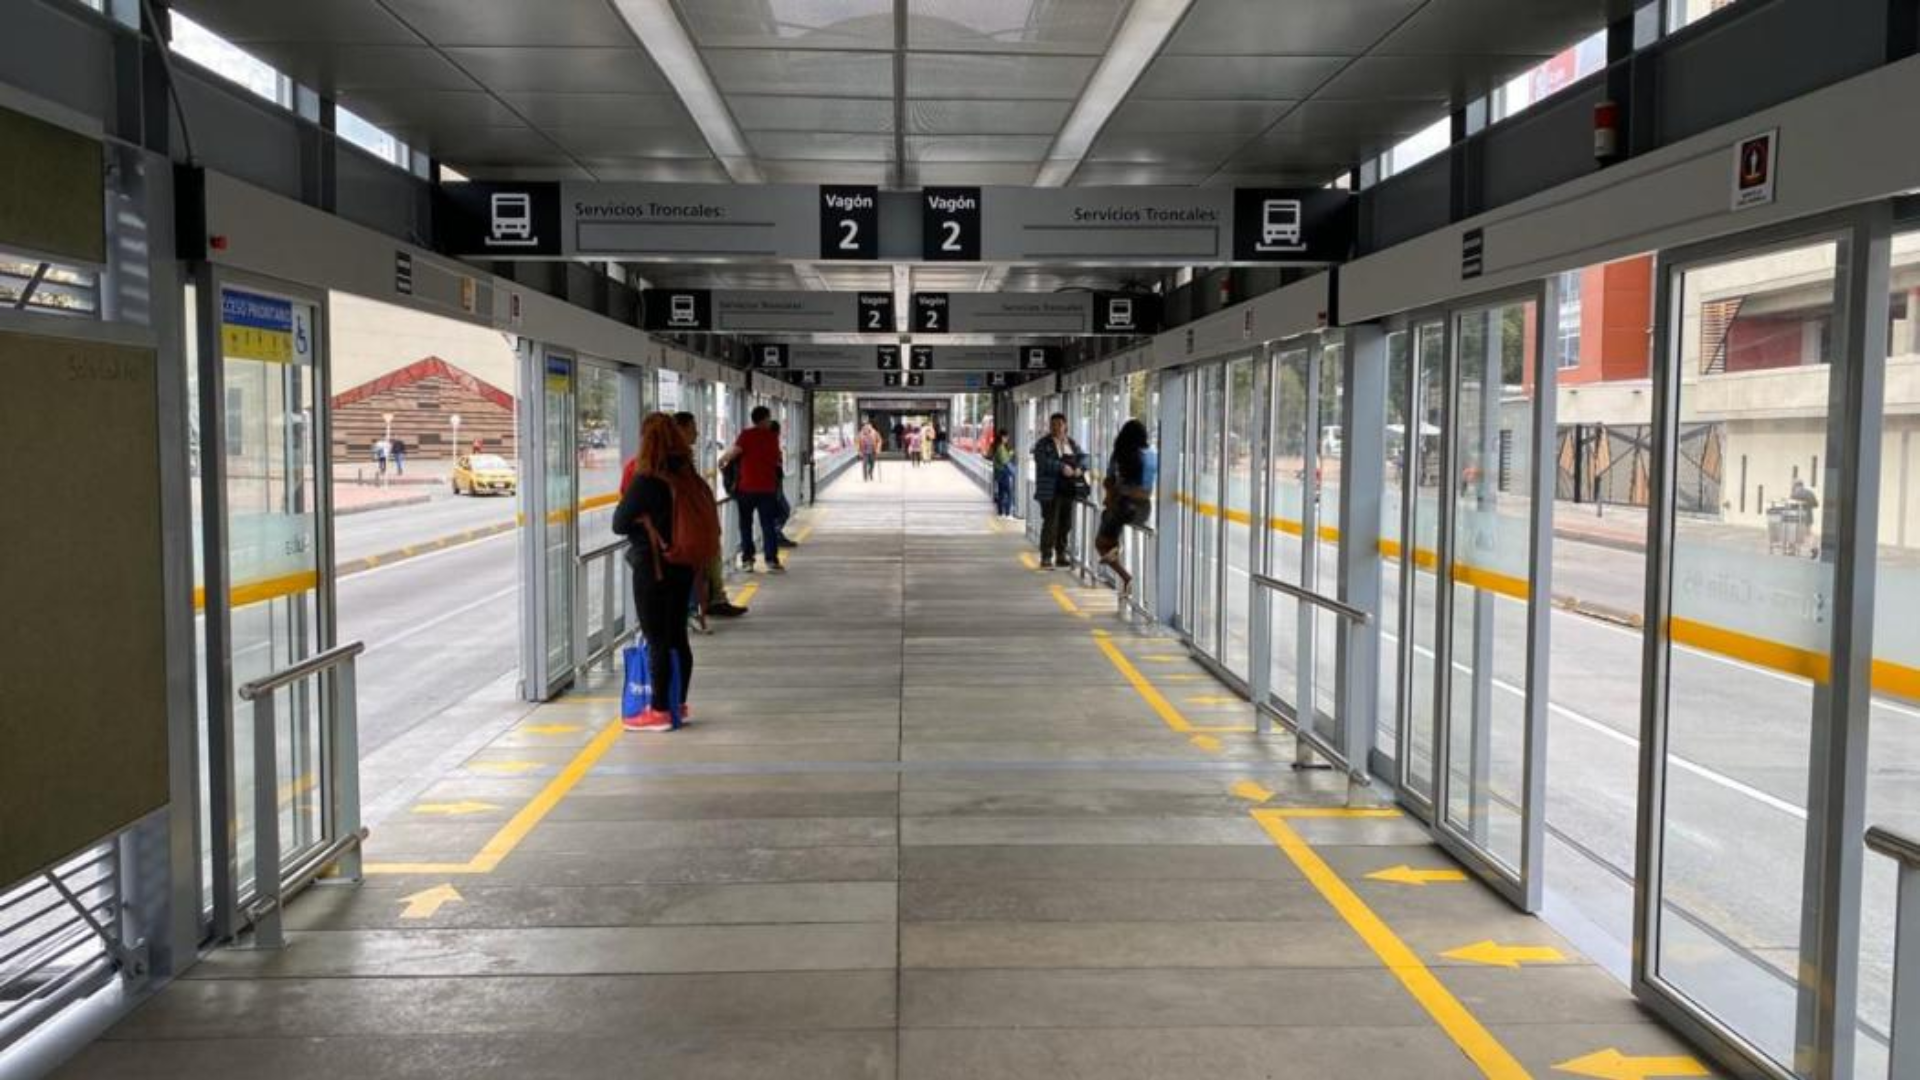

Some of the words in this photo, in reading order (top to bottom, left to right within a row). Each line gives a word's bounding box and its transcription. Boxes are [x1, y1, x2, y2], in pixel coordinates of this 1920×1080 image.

[575, 202, 643, 217] Servicios
[649, 202, 726, 218] Troncales:
[826, 193, 872, 211] Vagón
[928, 195, 975, 213] Vagón
[1074, 206, 1140, 221] Servicios
[1143, 206, 1220, 221] Troncales:
[839, 219, 859, 250] 2
[941, 221, 962, 251] 2
[868, 310, 882, 328] 2
[926, 310, 938, 328] 2
